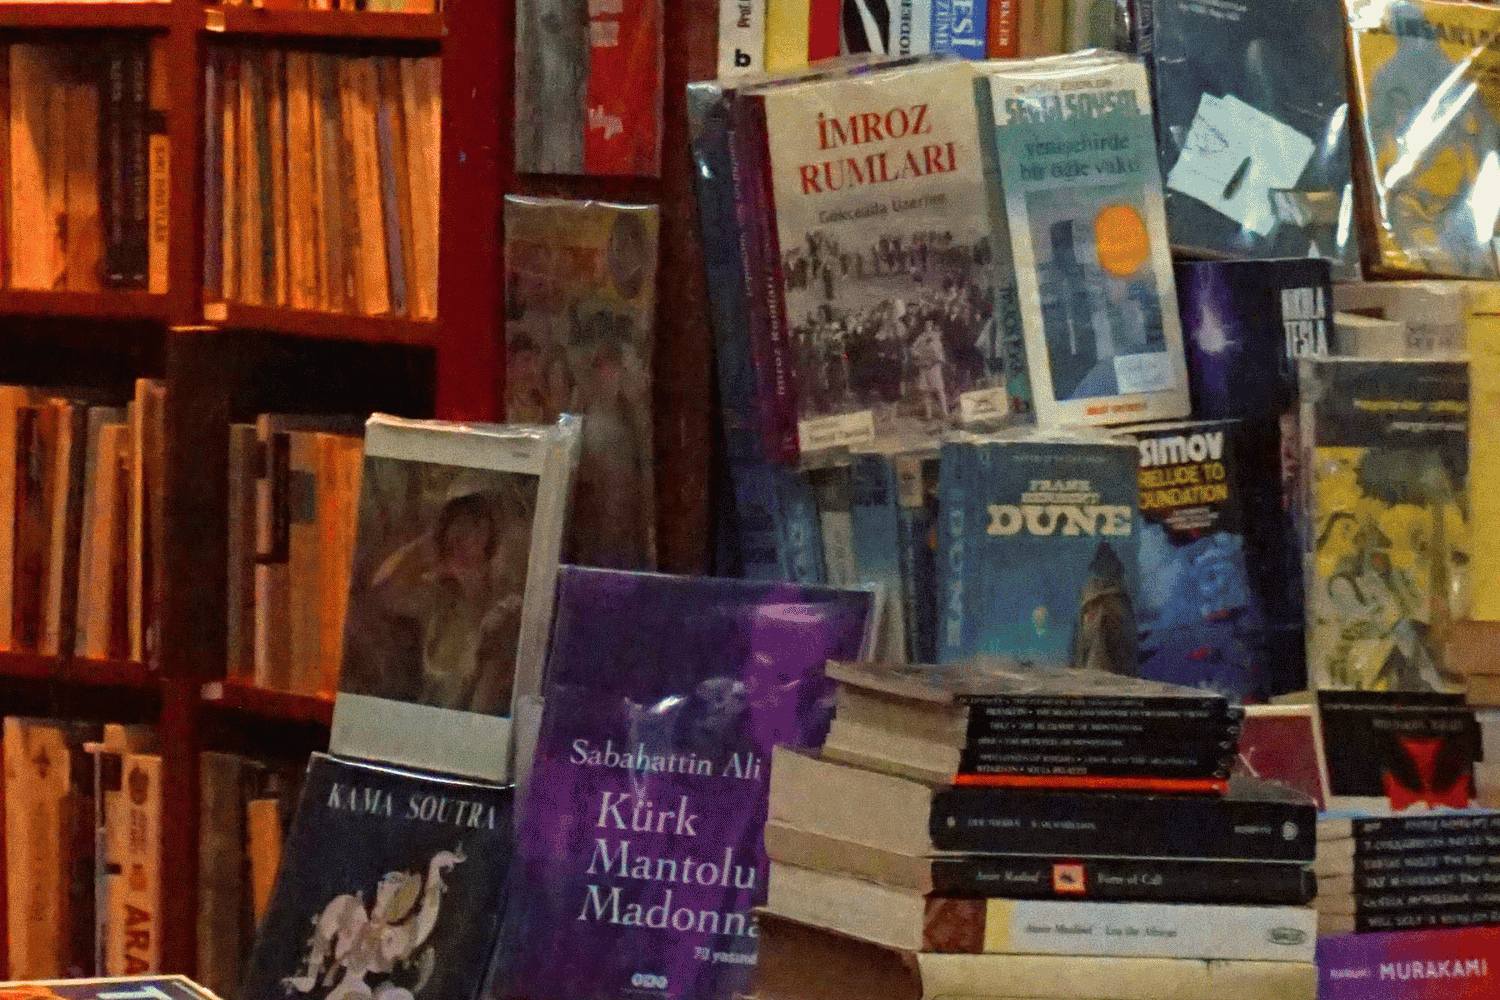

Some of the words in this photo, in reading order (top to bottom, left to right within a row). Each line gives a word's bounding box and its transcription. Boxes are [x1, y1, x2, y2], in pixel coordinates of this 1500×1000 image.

[817, 103, 932, 150] İMROZ
[798, 142, 958, 195] RUMLARI
[987, 503, 1132, 537] DUNE
[569, 738, 713, 778] Sabahattin
[721, 751, 761, 779] Ali
[326, 782, 395, 819] KAMA
[406, 793, 497, 831] SOUTRA
[596, 790, 697, 837] Kürk
[585, 837, 757, 890] Mantolu
[1379, 958, 1488, 982] MURAKAMI
